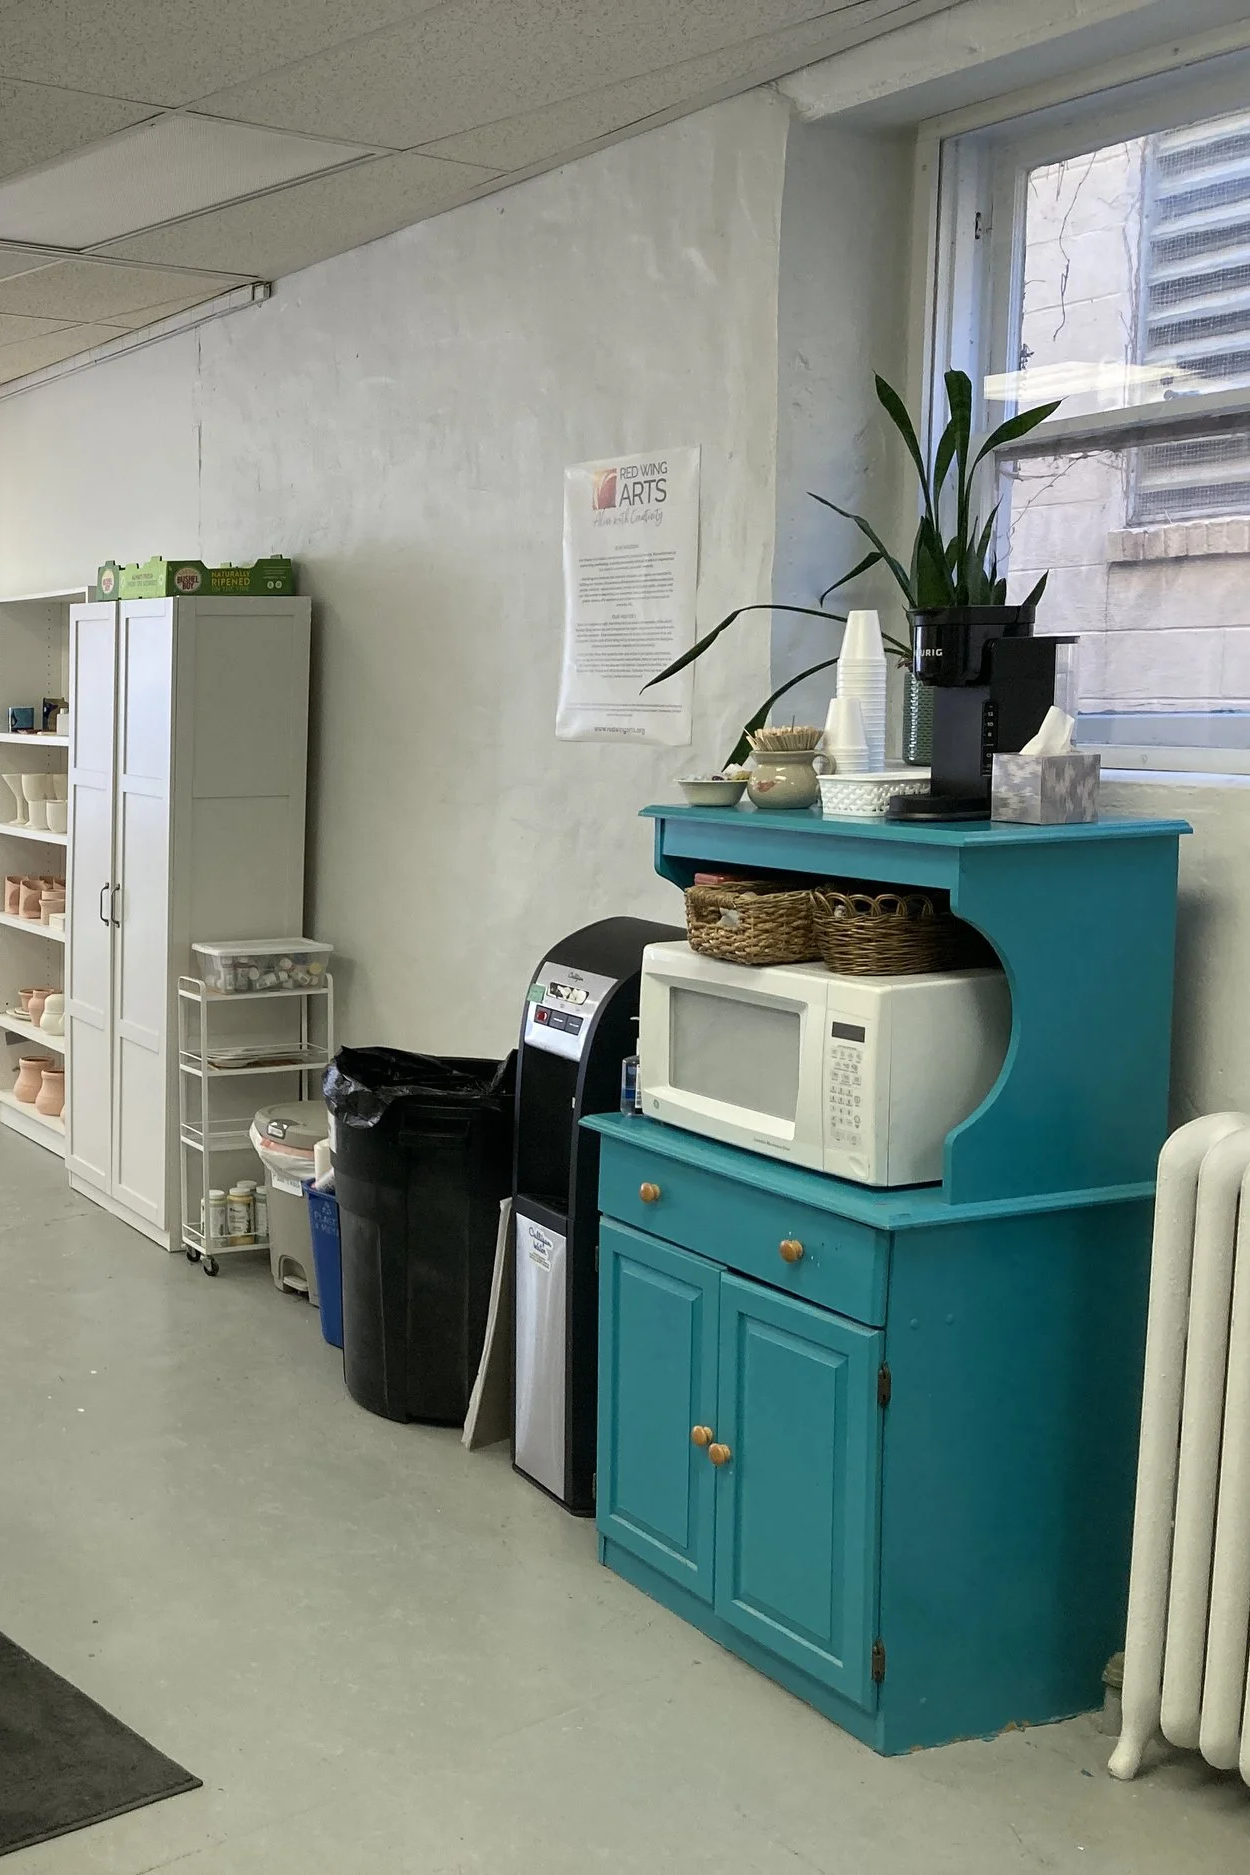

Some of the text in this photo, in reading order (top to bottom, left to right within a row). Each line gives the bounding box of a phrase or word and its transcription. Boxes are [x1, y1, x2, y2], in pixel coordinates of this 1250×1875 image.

[619, 461, 668, 480] RED WING
[619, 478, 667, 508] ARTS
[210, 569, 251, 578] NATURALLY
[210, 578, 251, 587] RIPENED
